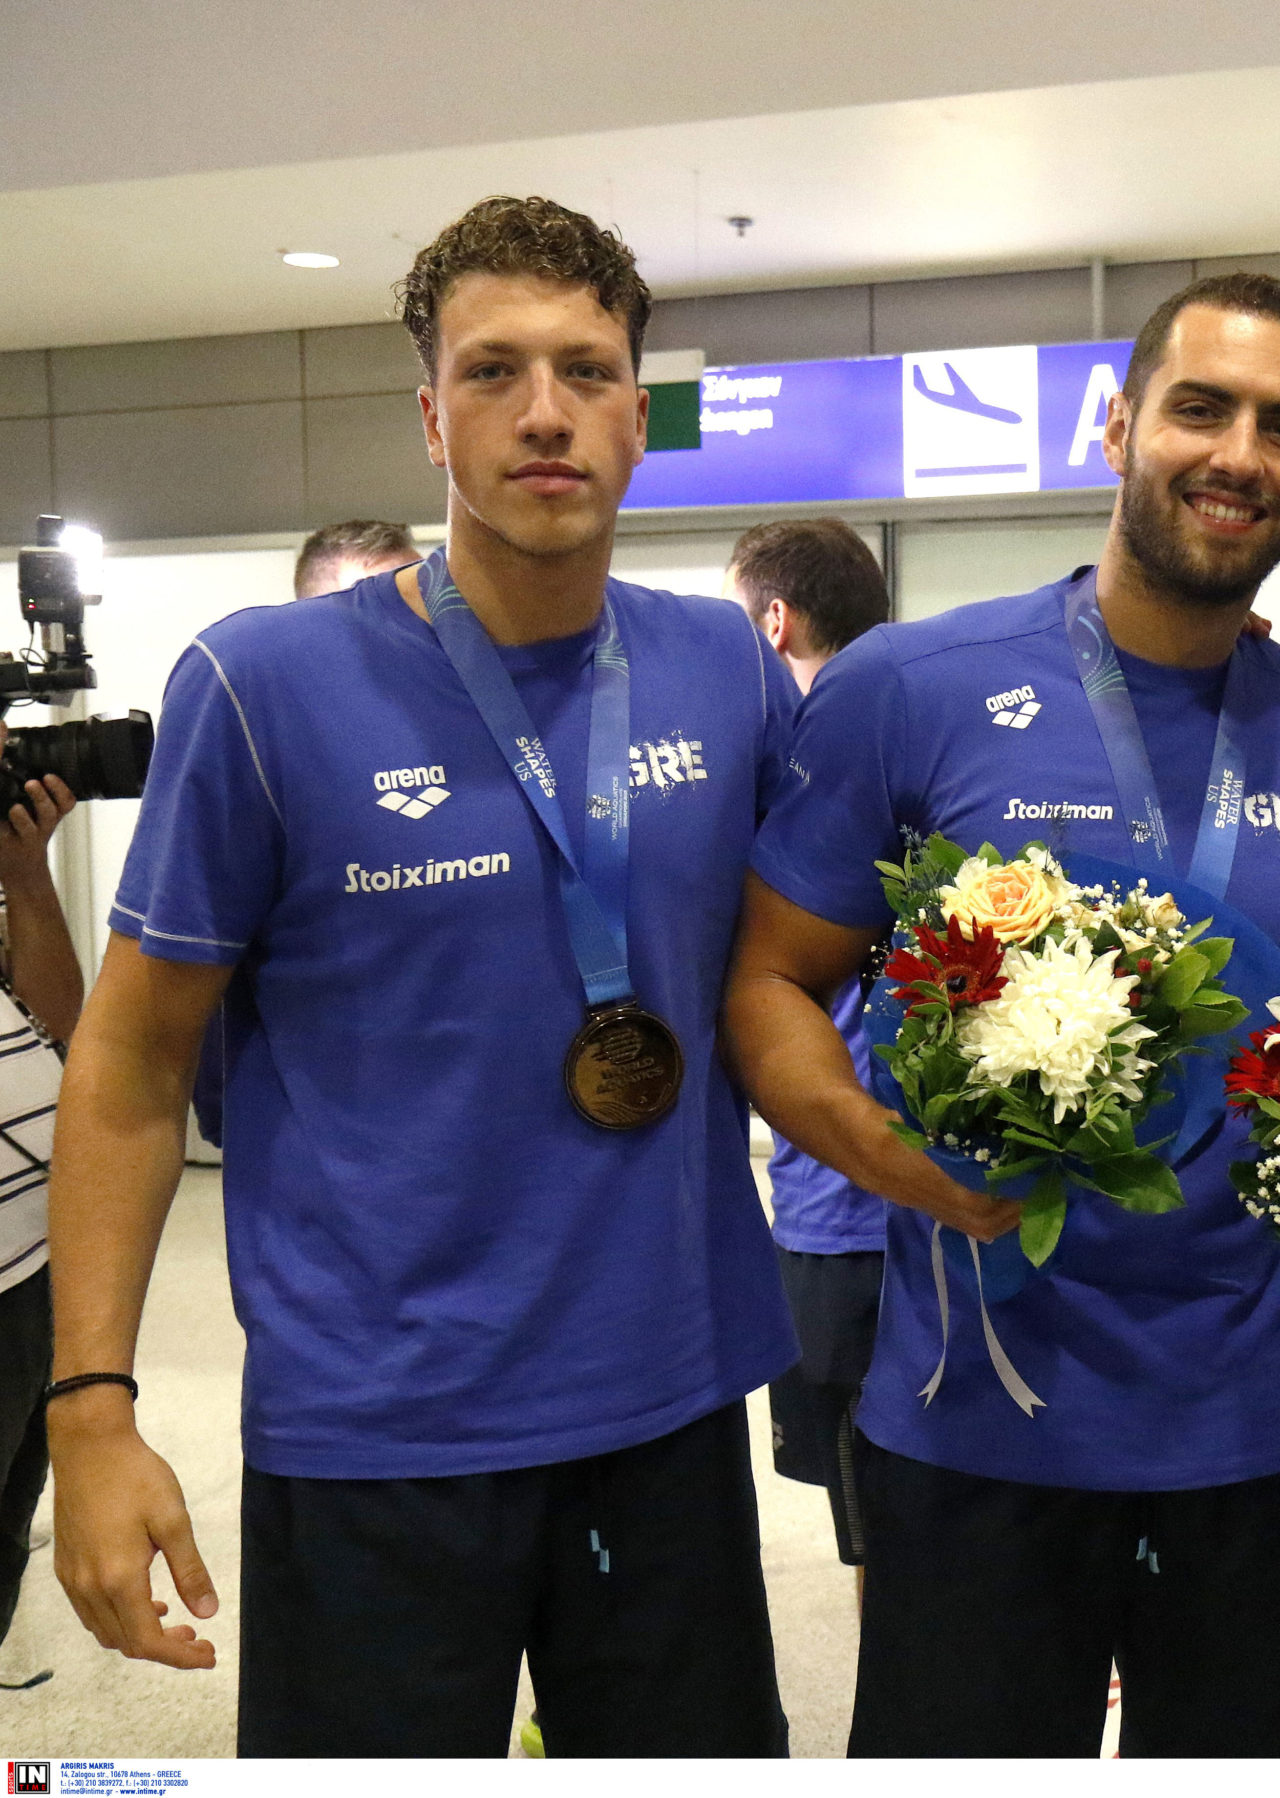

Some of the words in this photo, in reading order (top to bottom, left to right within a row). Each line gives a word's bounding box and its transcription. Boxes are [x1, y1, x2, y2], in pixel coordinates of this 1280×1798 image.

[985, 684, 1036, 713] arena
[374, 765, 446, 792] arena
[513, 761, 533, 782] US
[515, 736, 556, 798] SHAPES
[1206, 784, 1219, 802] US
[1214, 768, 1233, 829] SHAPES
[1226, 780, 1243, 825] WATER
[1003, 798, 1113, 820] Stoiximan
[344, 851, 511, 893] Stoiximan
